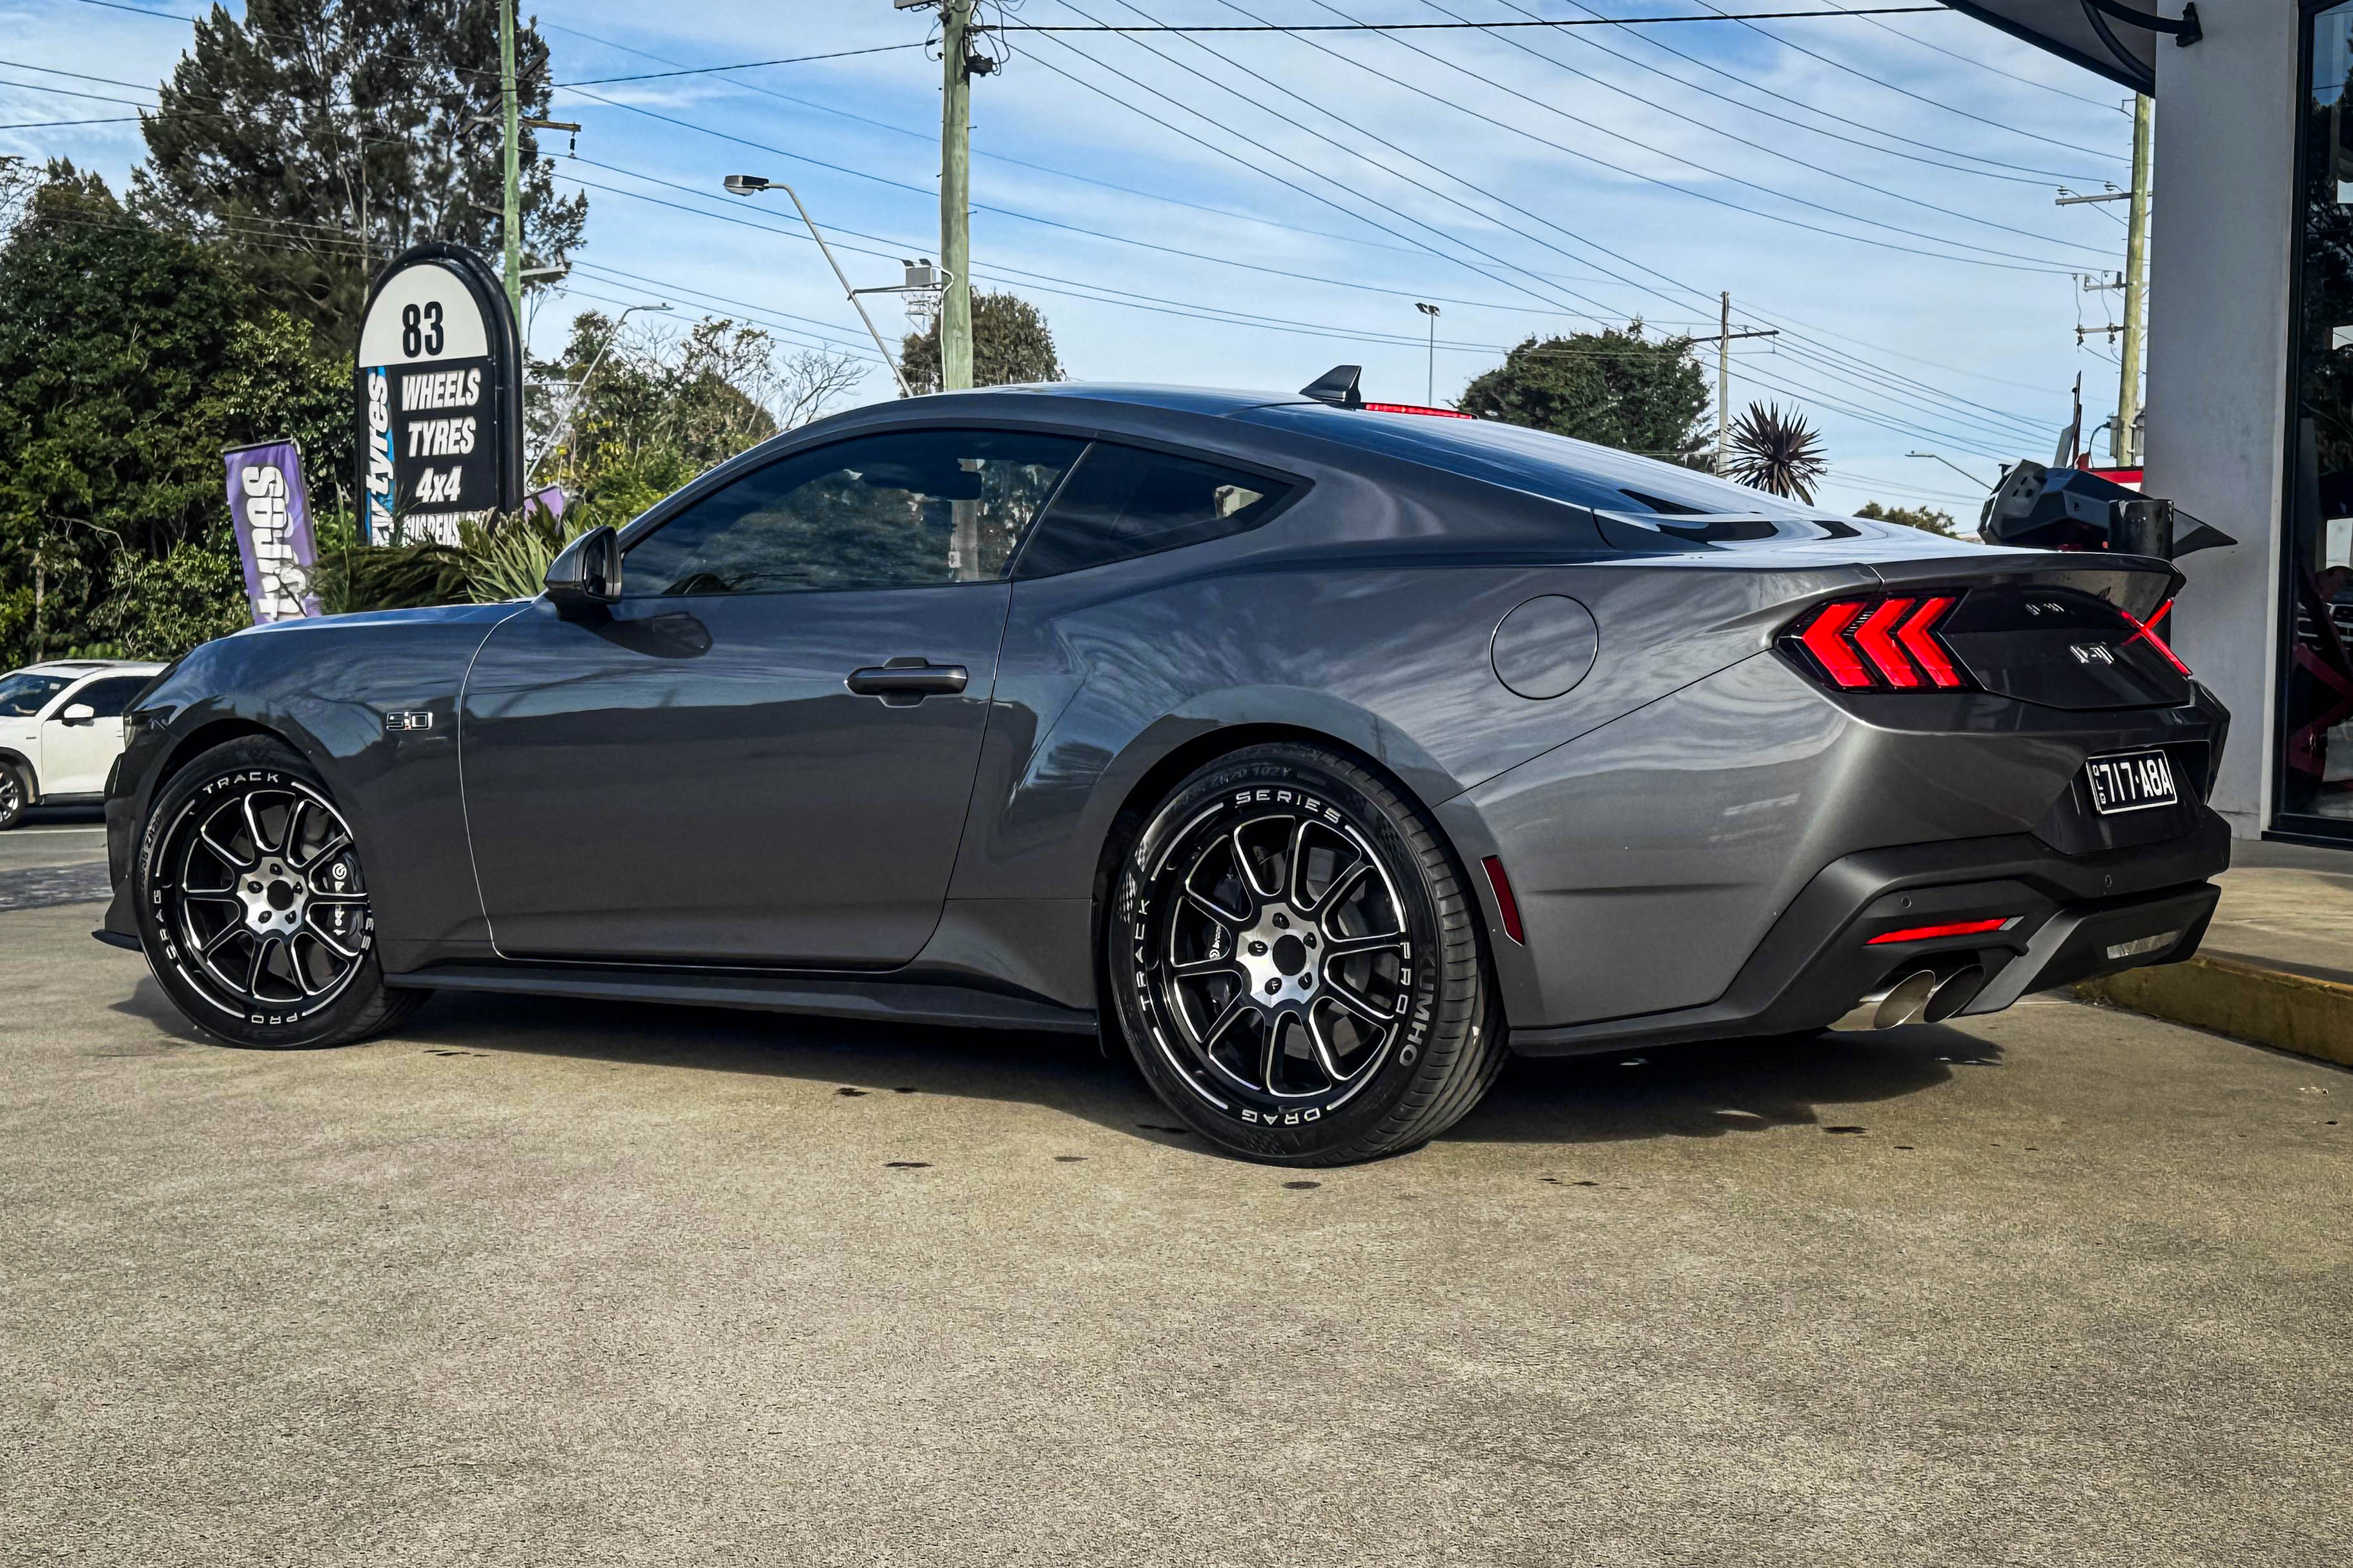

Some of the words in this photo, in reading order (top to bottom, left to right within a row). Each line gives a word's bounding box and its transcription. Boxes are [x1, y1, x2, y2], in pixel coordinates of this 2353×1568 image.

[402, 301, 444, 358] 83
[402, 367, 481, 412] WHEELS
[365, 372, 394, 495] tyres
[408, 416, 477, 457] TYRES
[242, 467, 306, 618] tyres
[203, 771, 279, 794] TRACK
[1235, 789, 1341, 824] SERIES
[153, 890, 178, 961] DRAG
[1135, 899, 1151, 1012] TRACK
[1395, 942, 1411, 1015] PRO
[252, 1013, 297, 1024] PRO
[1399, 945, 1436, 1066] KUMHO
[1242, 1107, 1321, 1125] DRAG
